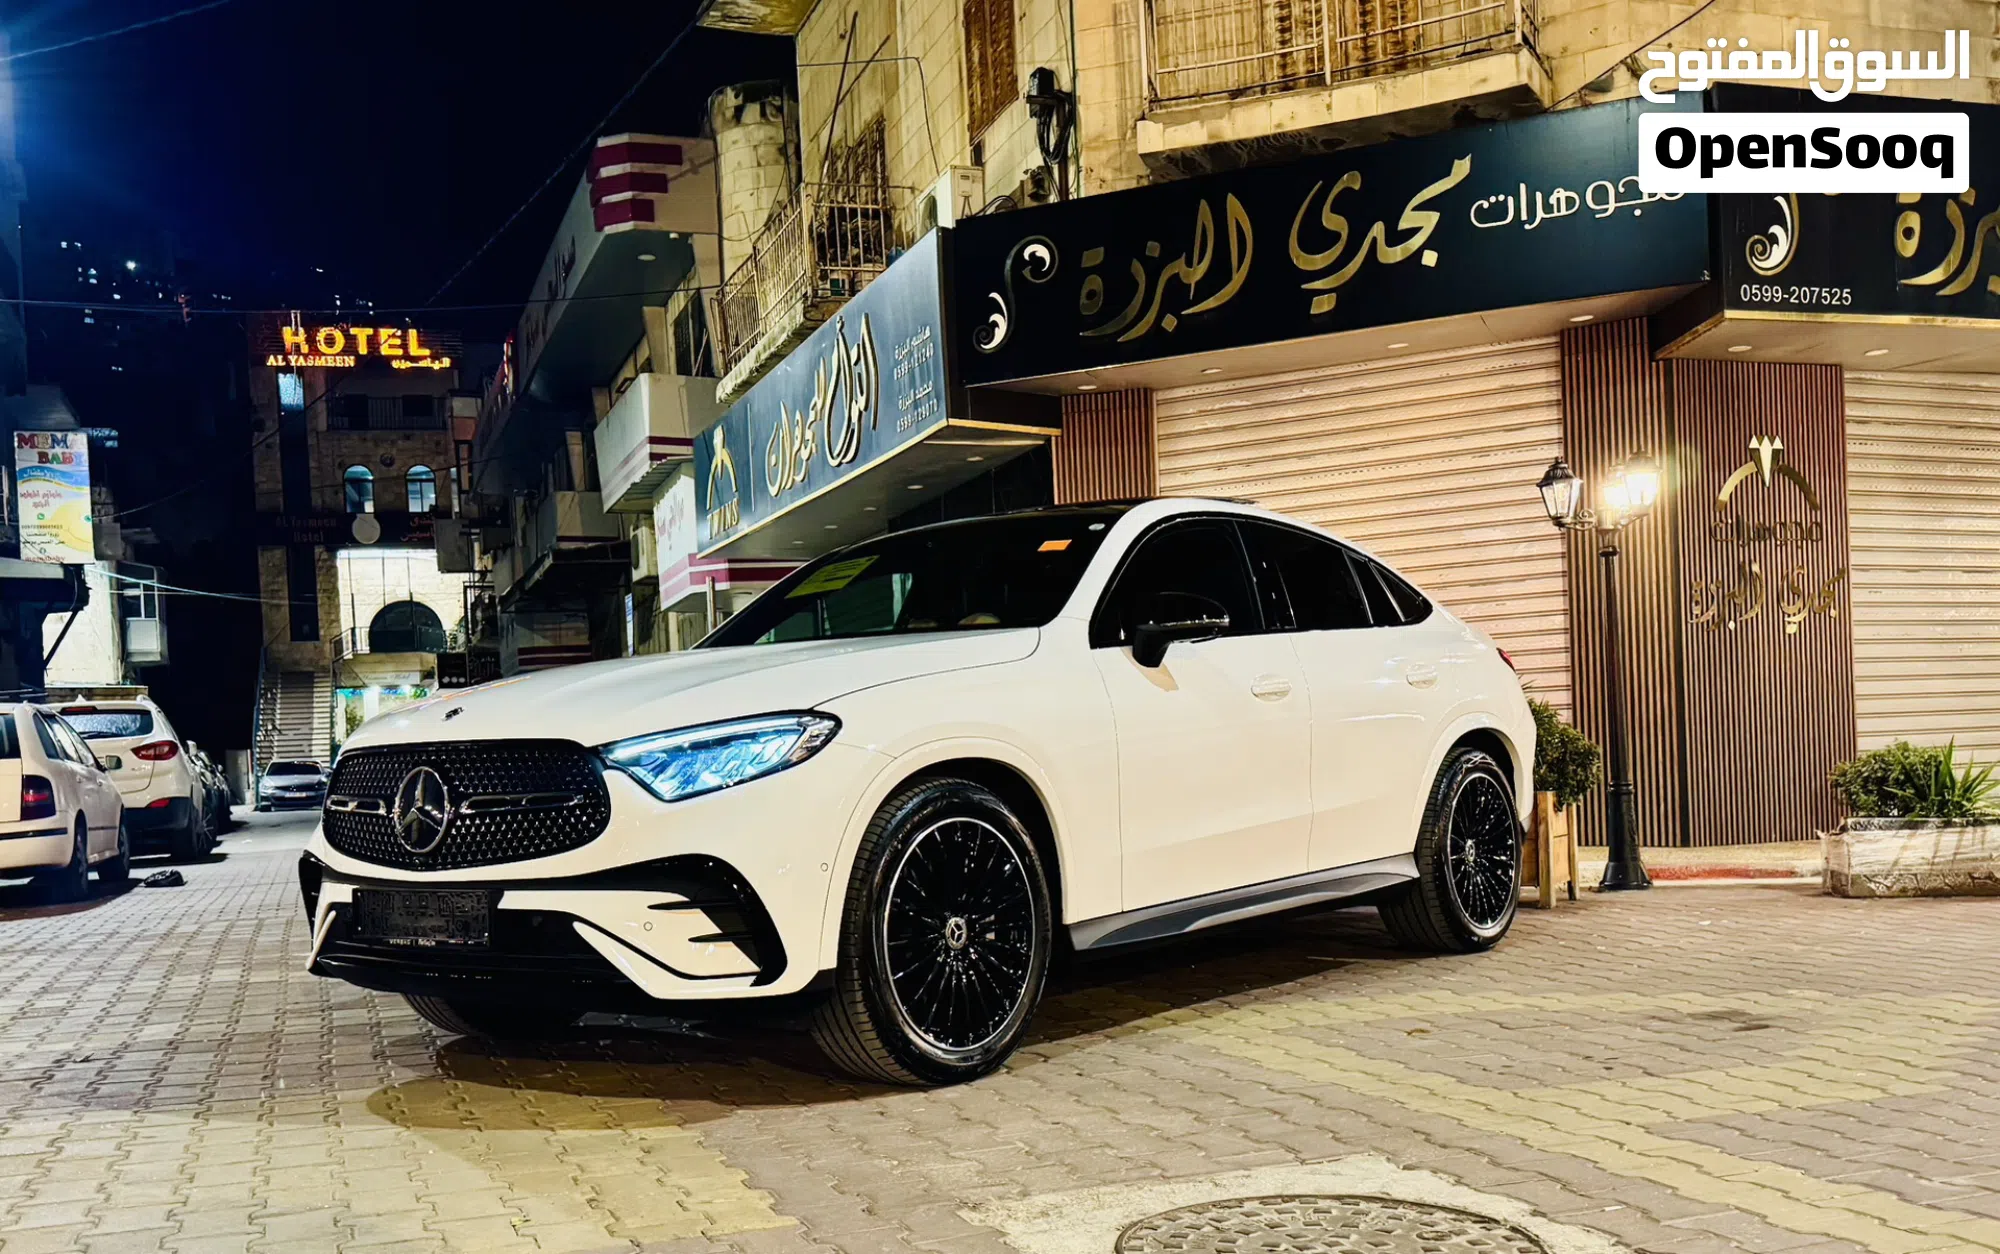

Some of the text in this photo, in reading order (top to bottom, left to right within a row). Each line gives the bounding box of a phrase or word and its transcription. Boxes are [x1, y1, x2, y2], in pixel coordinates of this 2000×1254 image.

[1079, 153, 1472, 343] مجدي البزرة
[1740, 282, 1853, 307] 0599-207525
[281, 326, 432, 356] HOTEL
[266, 354, 356, 368] AL YASMEEN
[391, 356, 452, 370] الياسمين
[705, 497, 741, 541] TWINS
